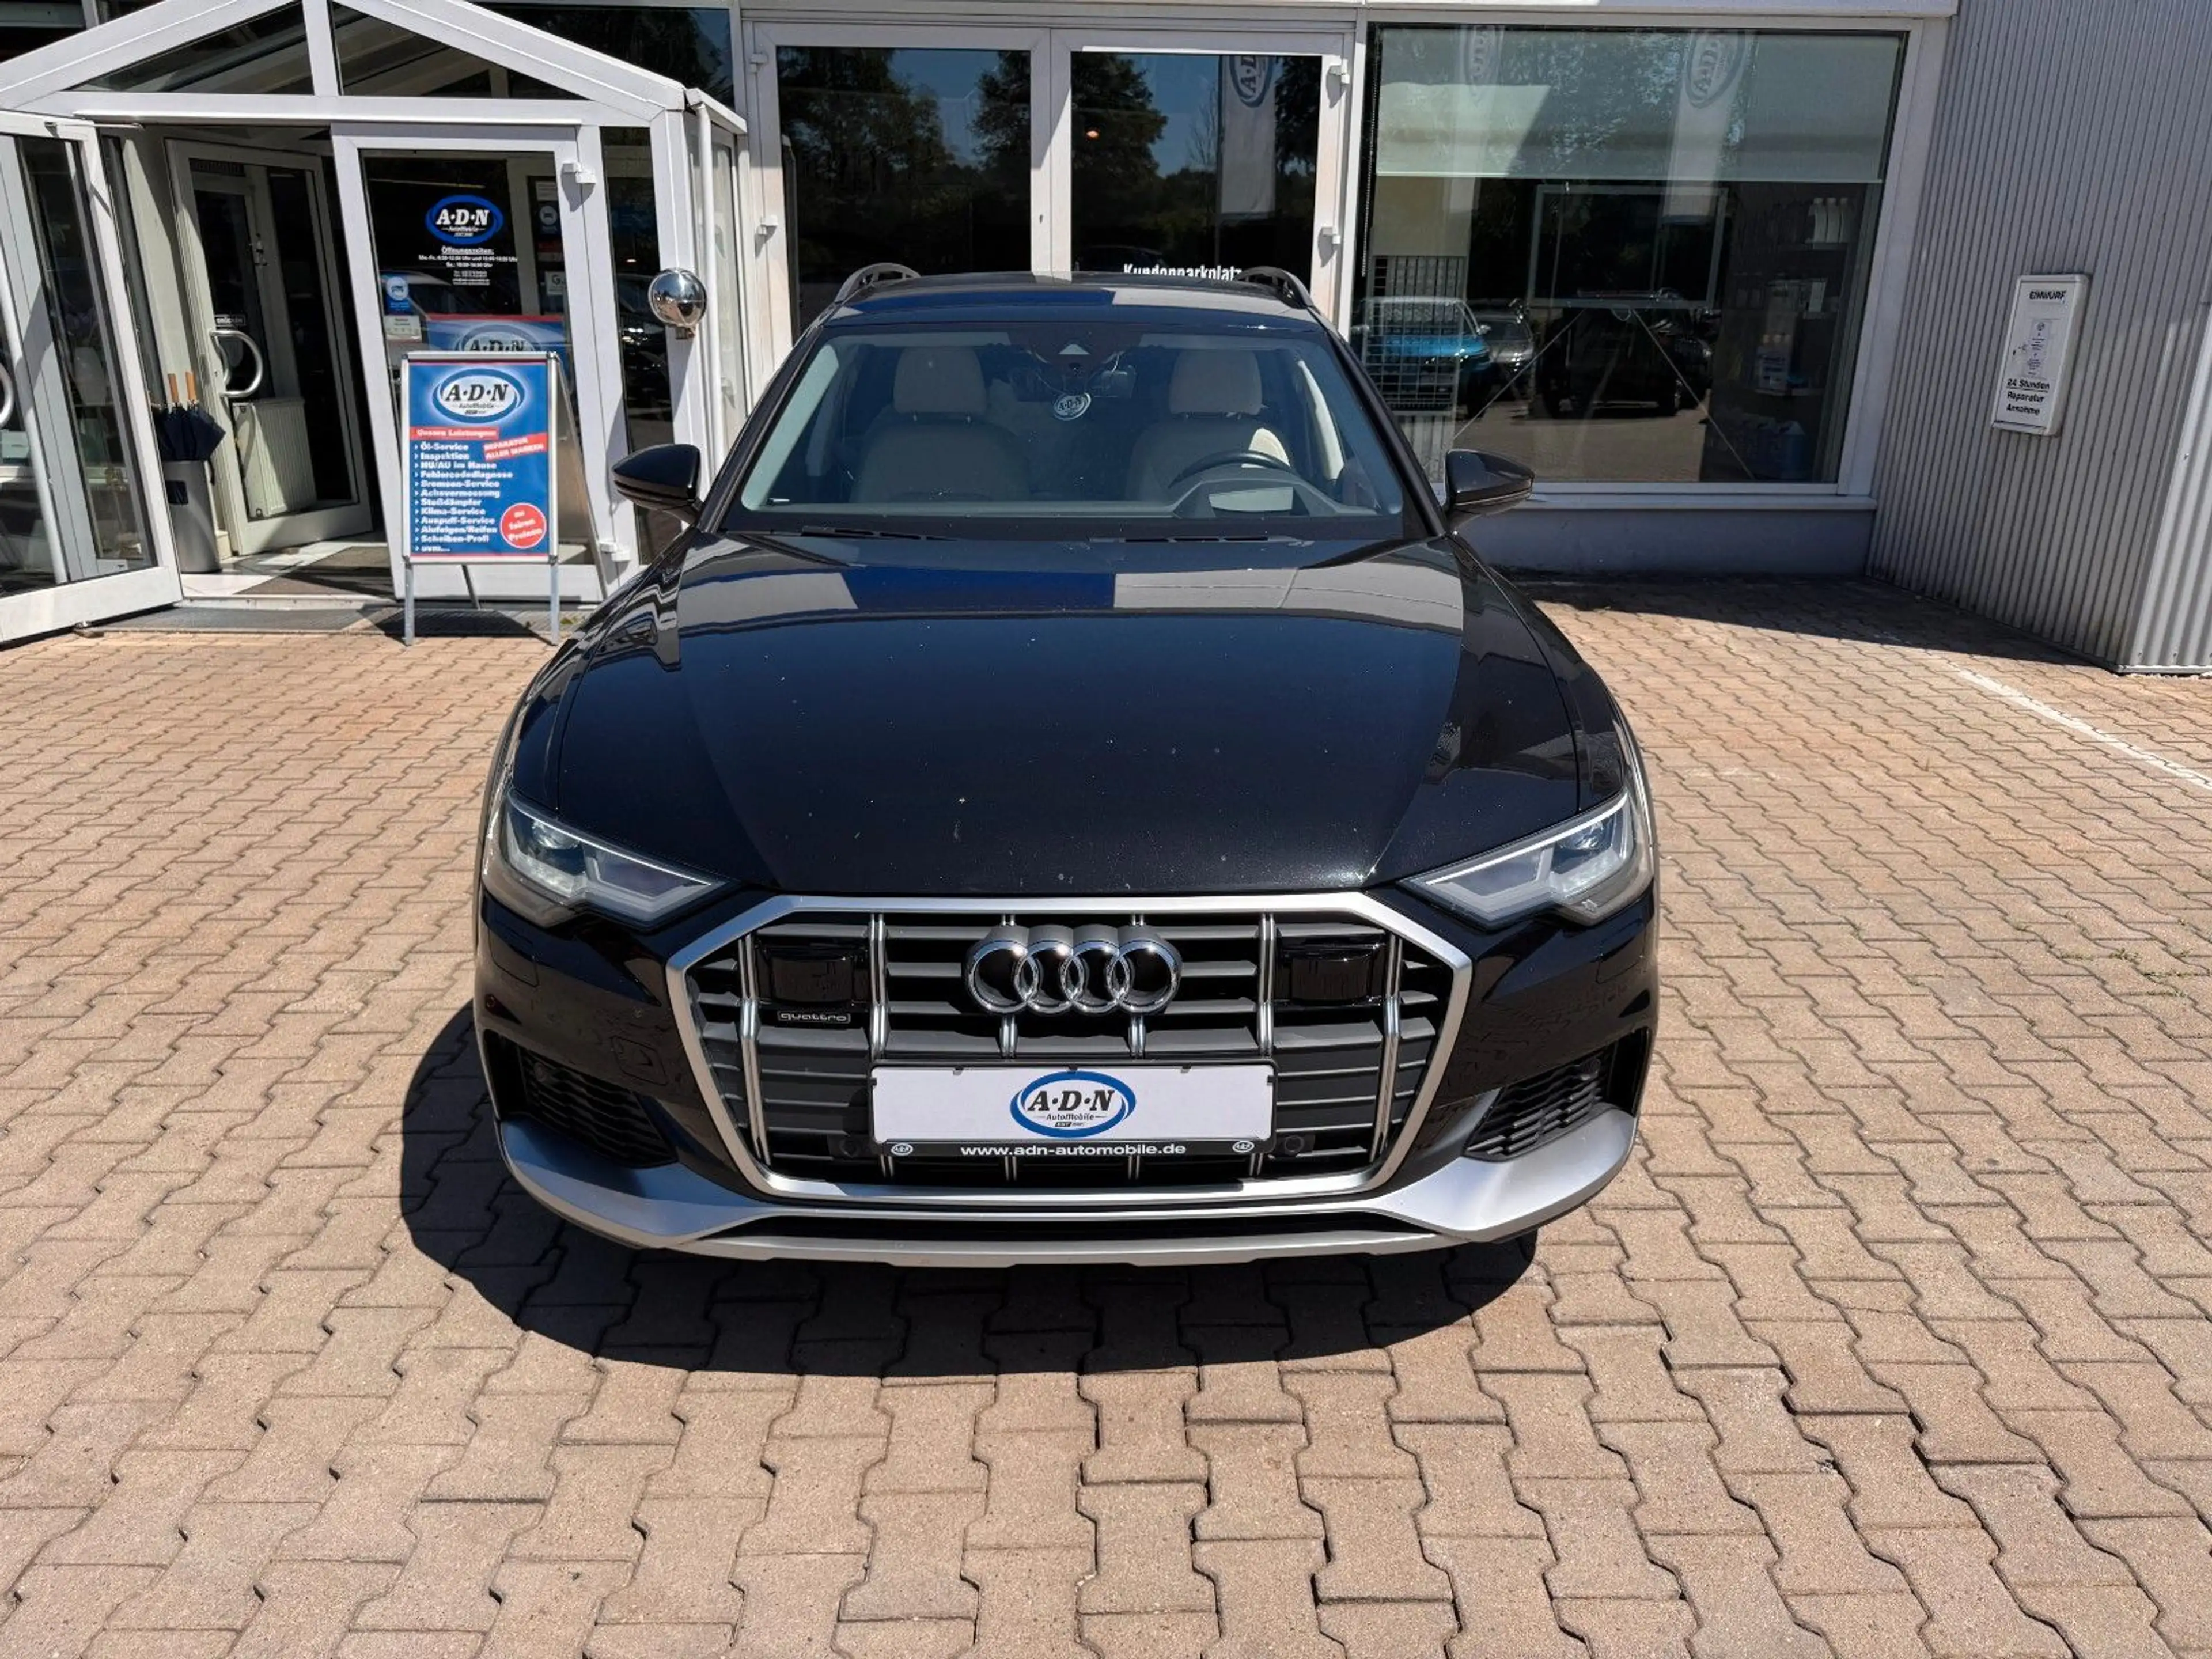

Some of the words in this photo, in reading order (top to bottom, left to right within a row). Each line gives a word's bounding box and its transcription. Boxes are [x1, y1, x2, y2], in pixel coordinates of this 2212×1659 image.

[2006, 378, 2017, 387] 24
[2019, 379, 2050, 389] Stunden
[445, 384, 509, 402] A·D·N
[2007, 391, 2044, 402] Reparatur
[420, 441, 469, 450] Öl-Service
[420, 452, 469, 462] Inspektion
[420, 461, 451, 469] HU/AU
[467, 461, 497, 469] Hause
[420, 471, 513, 480] Fehlercodediagnose
[421, 479, 500, 488] Bremsen-Service
[421, 489, 501, 498] Achsvermessung
[421, 498, 482, 507] Stoßdämpfer
[421, 507, 486, 516] Klima-Service
[421, 517, 495, 525] Auspuff-Service
[421, 535, 489, 543] Scheiben-Profi
[781, 1013, 847, 1022] quattro
[1027, 1089, 1116, 1111] A·D·N
[1046, 1113, 1094, 1121] AutoMobile
[960, 1143, 1187, 1156] www.adn-automobile.de
